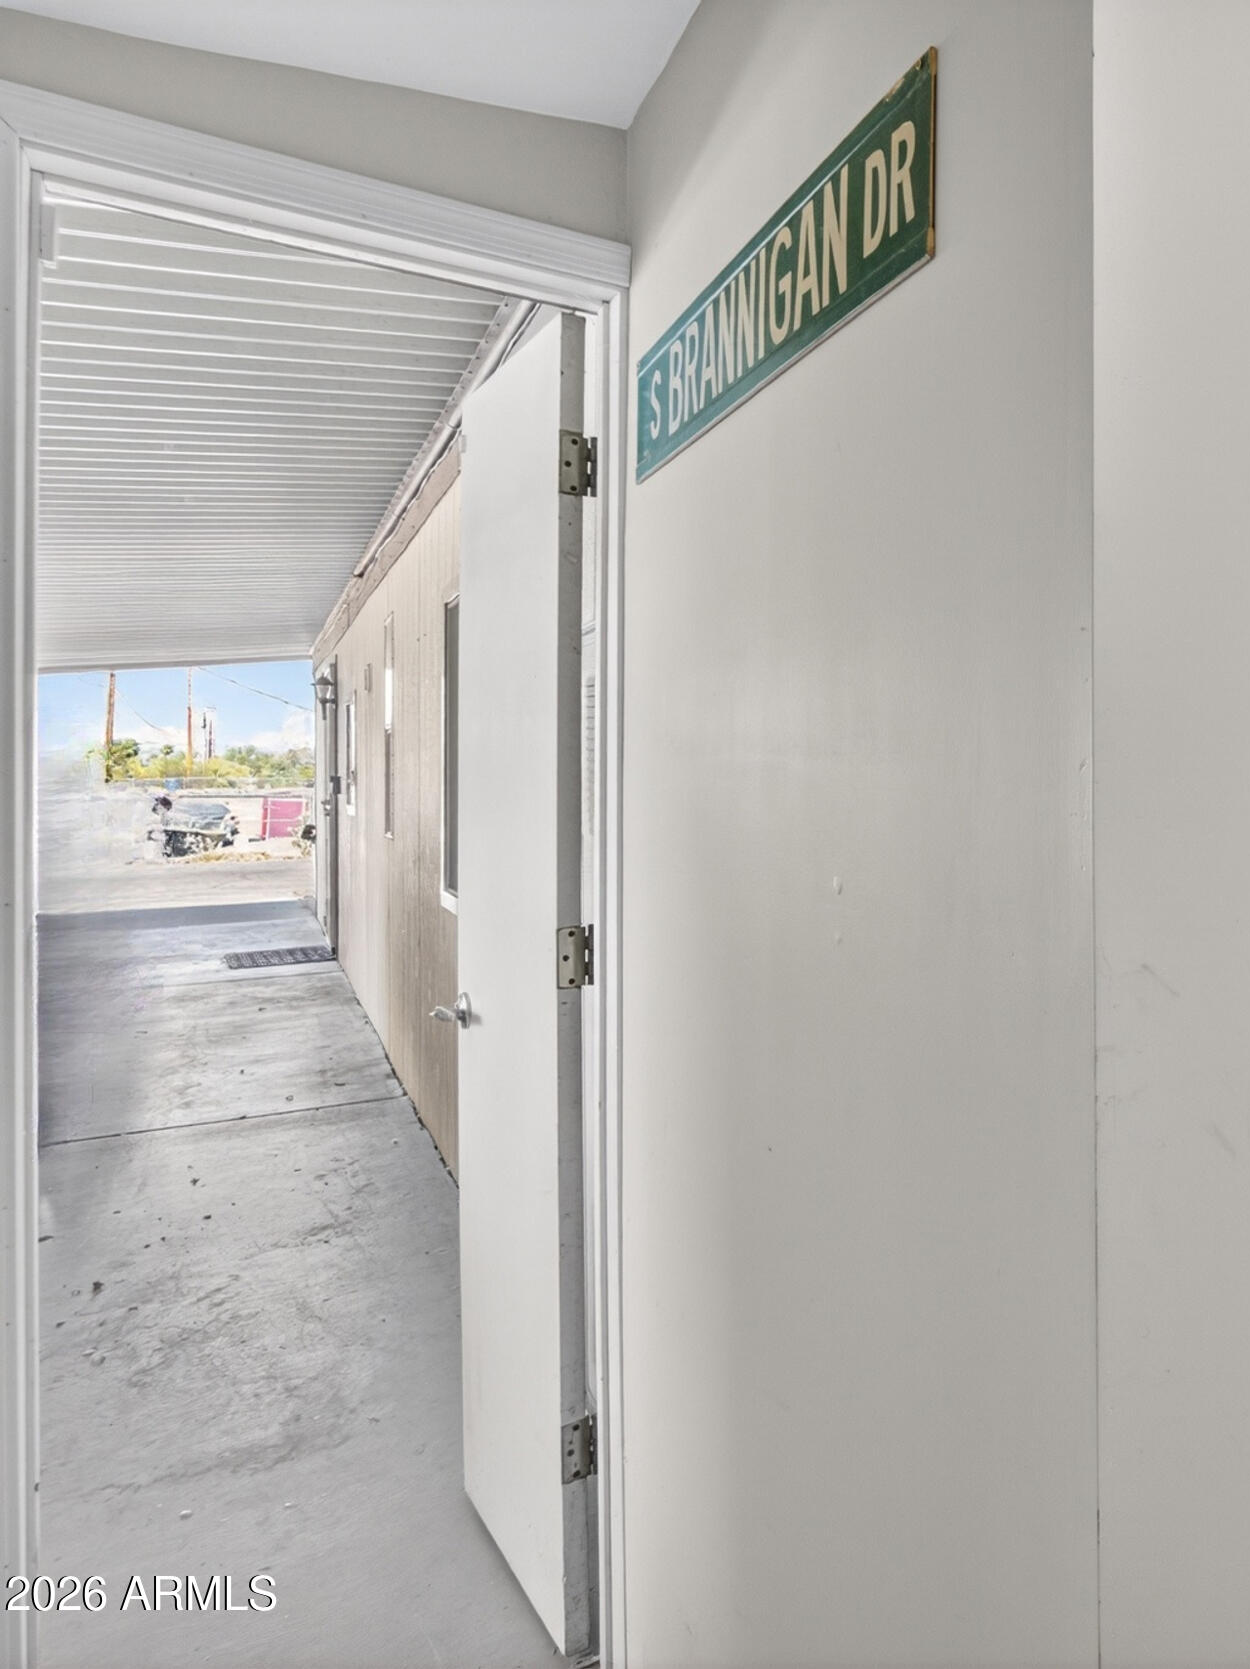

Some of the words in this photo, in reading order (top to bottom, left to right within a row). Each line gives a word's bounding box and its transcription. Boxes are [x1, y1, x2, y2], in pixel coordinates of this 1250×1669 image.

[650, 369, 661, 441] S
[668, 164, 849, 437] BRANNIGAN
[862, 120, 916, 259] DR
